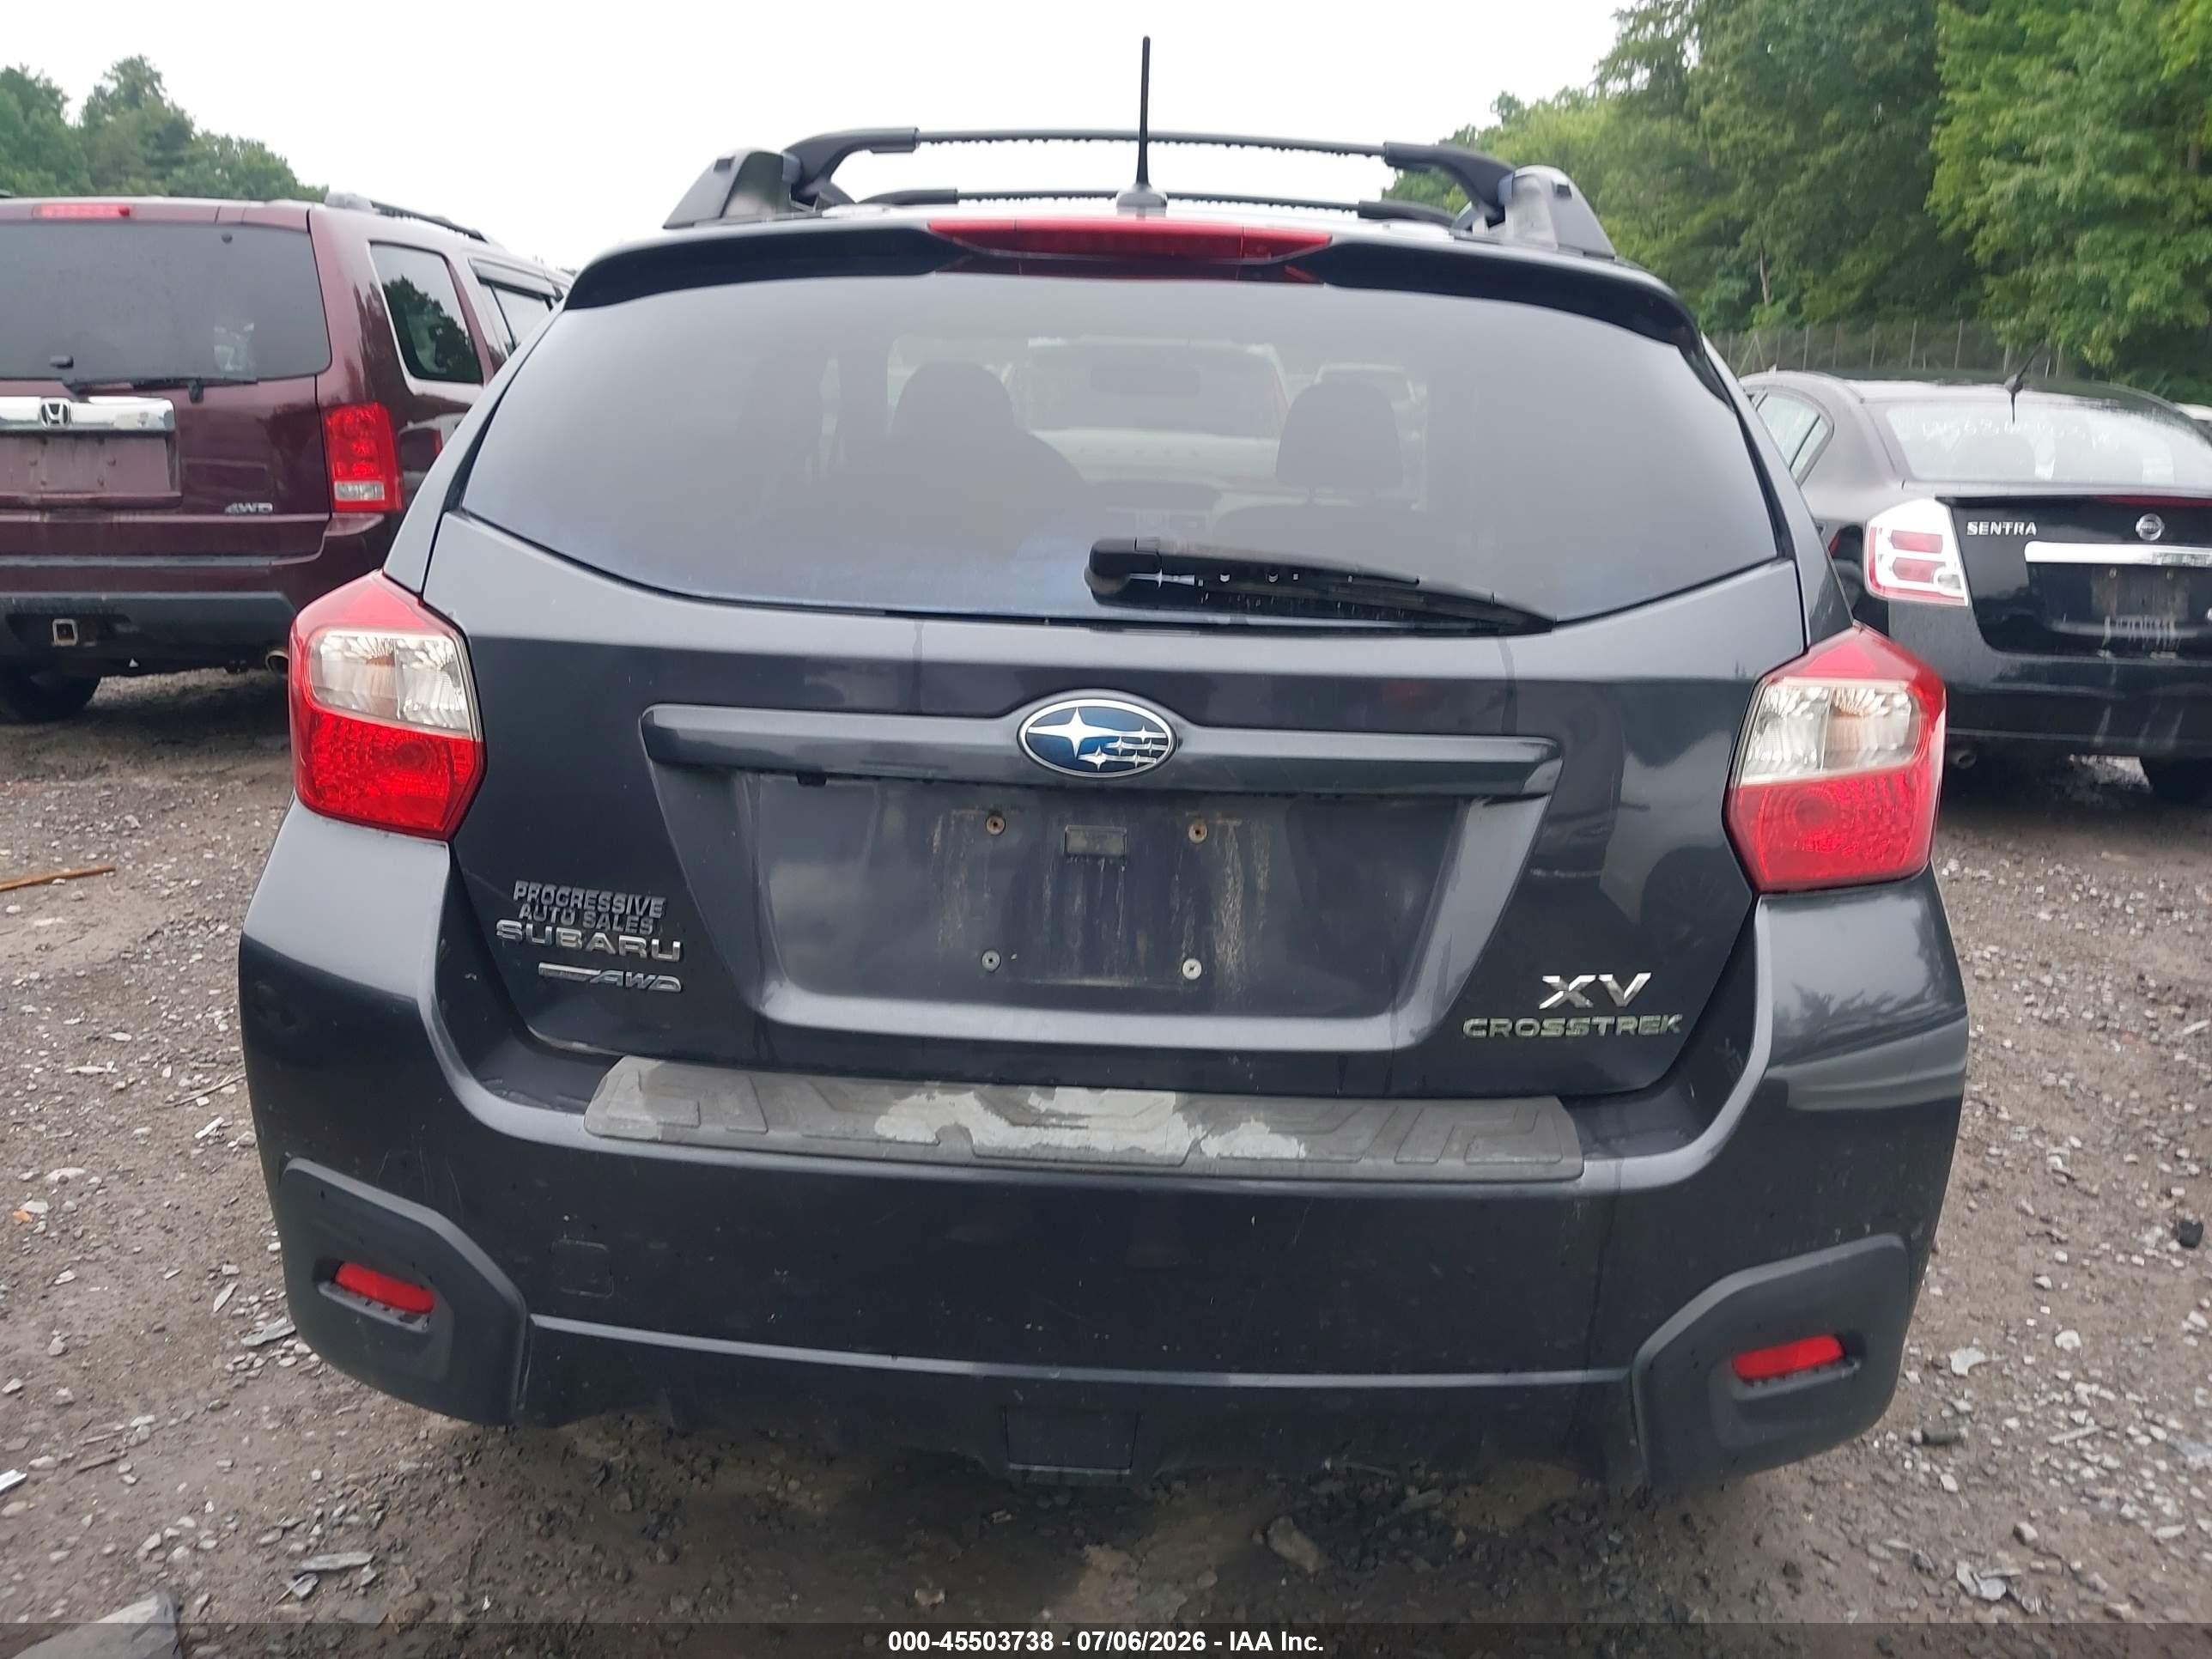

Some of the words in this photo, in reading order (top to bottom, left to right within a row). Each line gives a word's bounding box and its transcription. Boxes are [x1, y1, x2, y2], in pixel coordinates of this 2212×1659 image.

[225, 502, 274, 515] 4WD
[1966, 521, 2039, 537] SENTRA
[514, 878, 666, 919] PROGRESSIVE
[518, 902, 576, 926] AUTO
[582, 910, 654, 935] SALES
[495, 918, 682, 963] SUBARU
[589, 969, 682, 994] AWD
[1538, 972, 1652, 1010] XV
[1462, 1013, 1684, 1038] CROSSTREK
